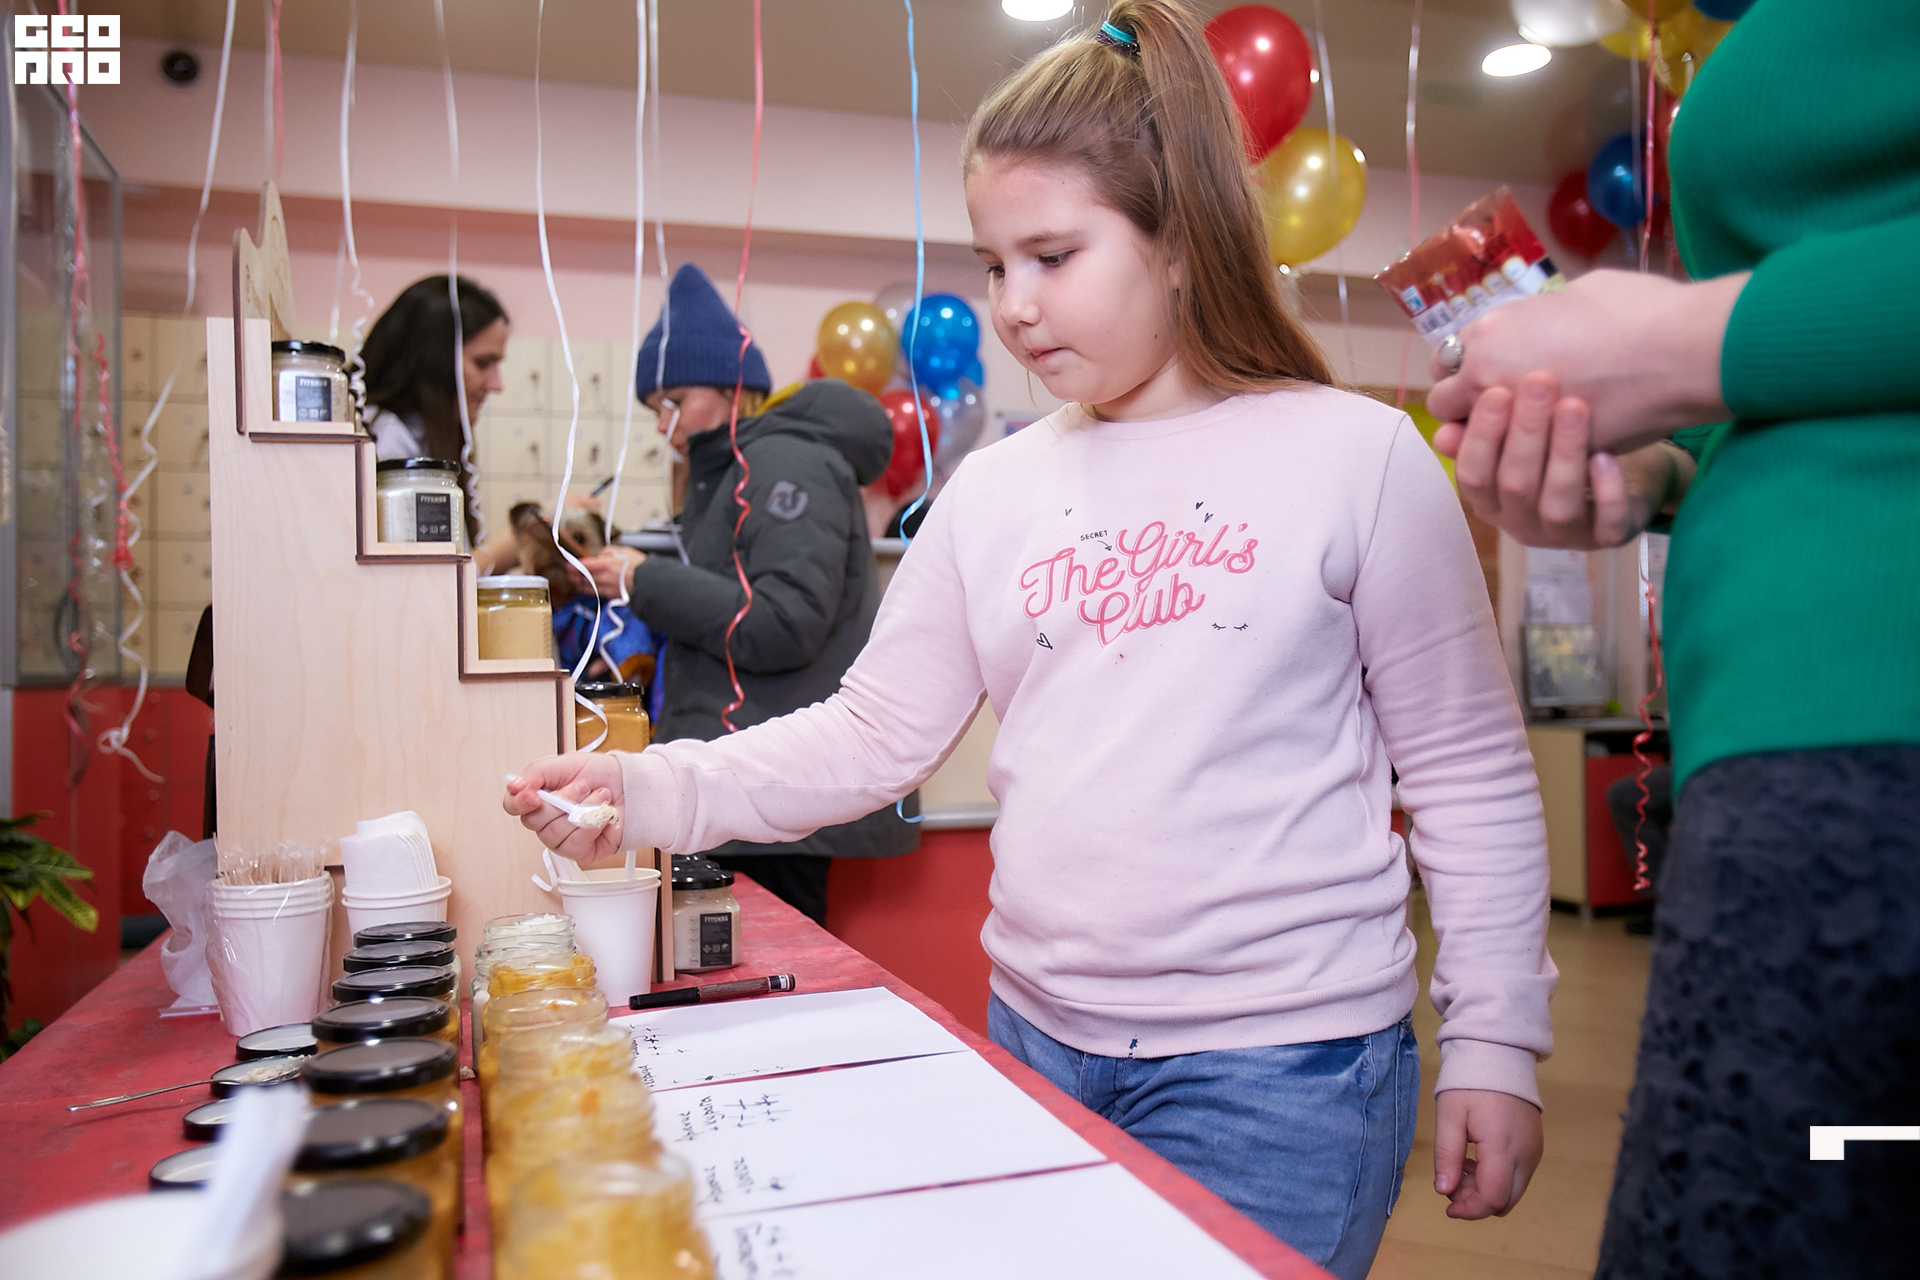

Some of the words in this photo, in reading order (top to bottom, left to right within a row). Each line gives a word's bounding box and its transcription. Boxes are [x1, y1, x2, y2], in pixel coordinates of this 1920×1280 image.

[1019, 547, 1126, 619] The
[1116, 520, 1258, 593] Girl's
[1080, 530, 1109, 541] SECRET
[1077, 573, 1206, 647] Club
